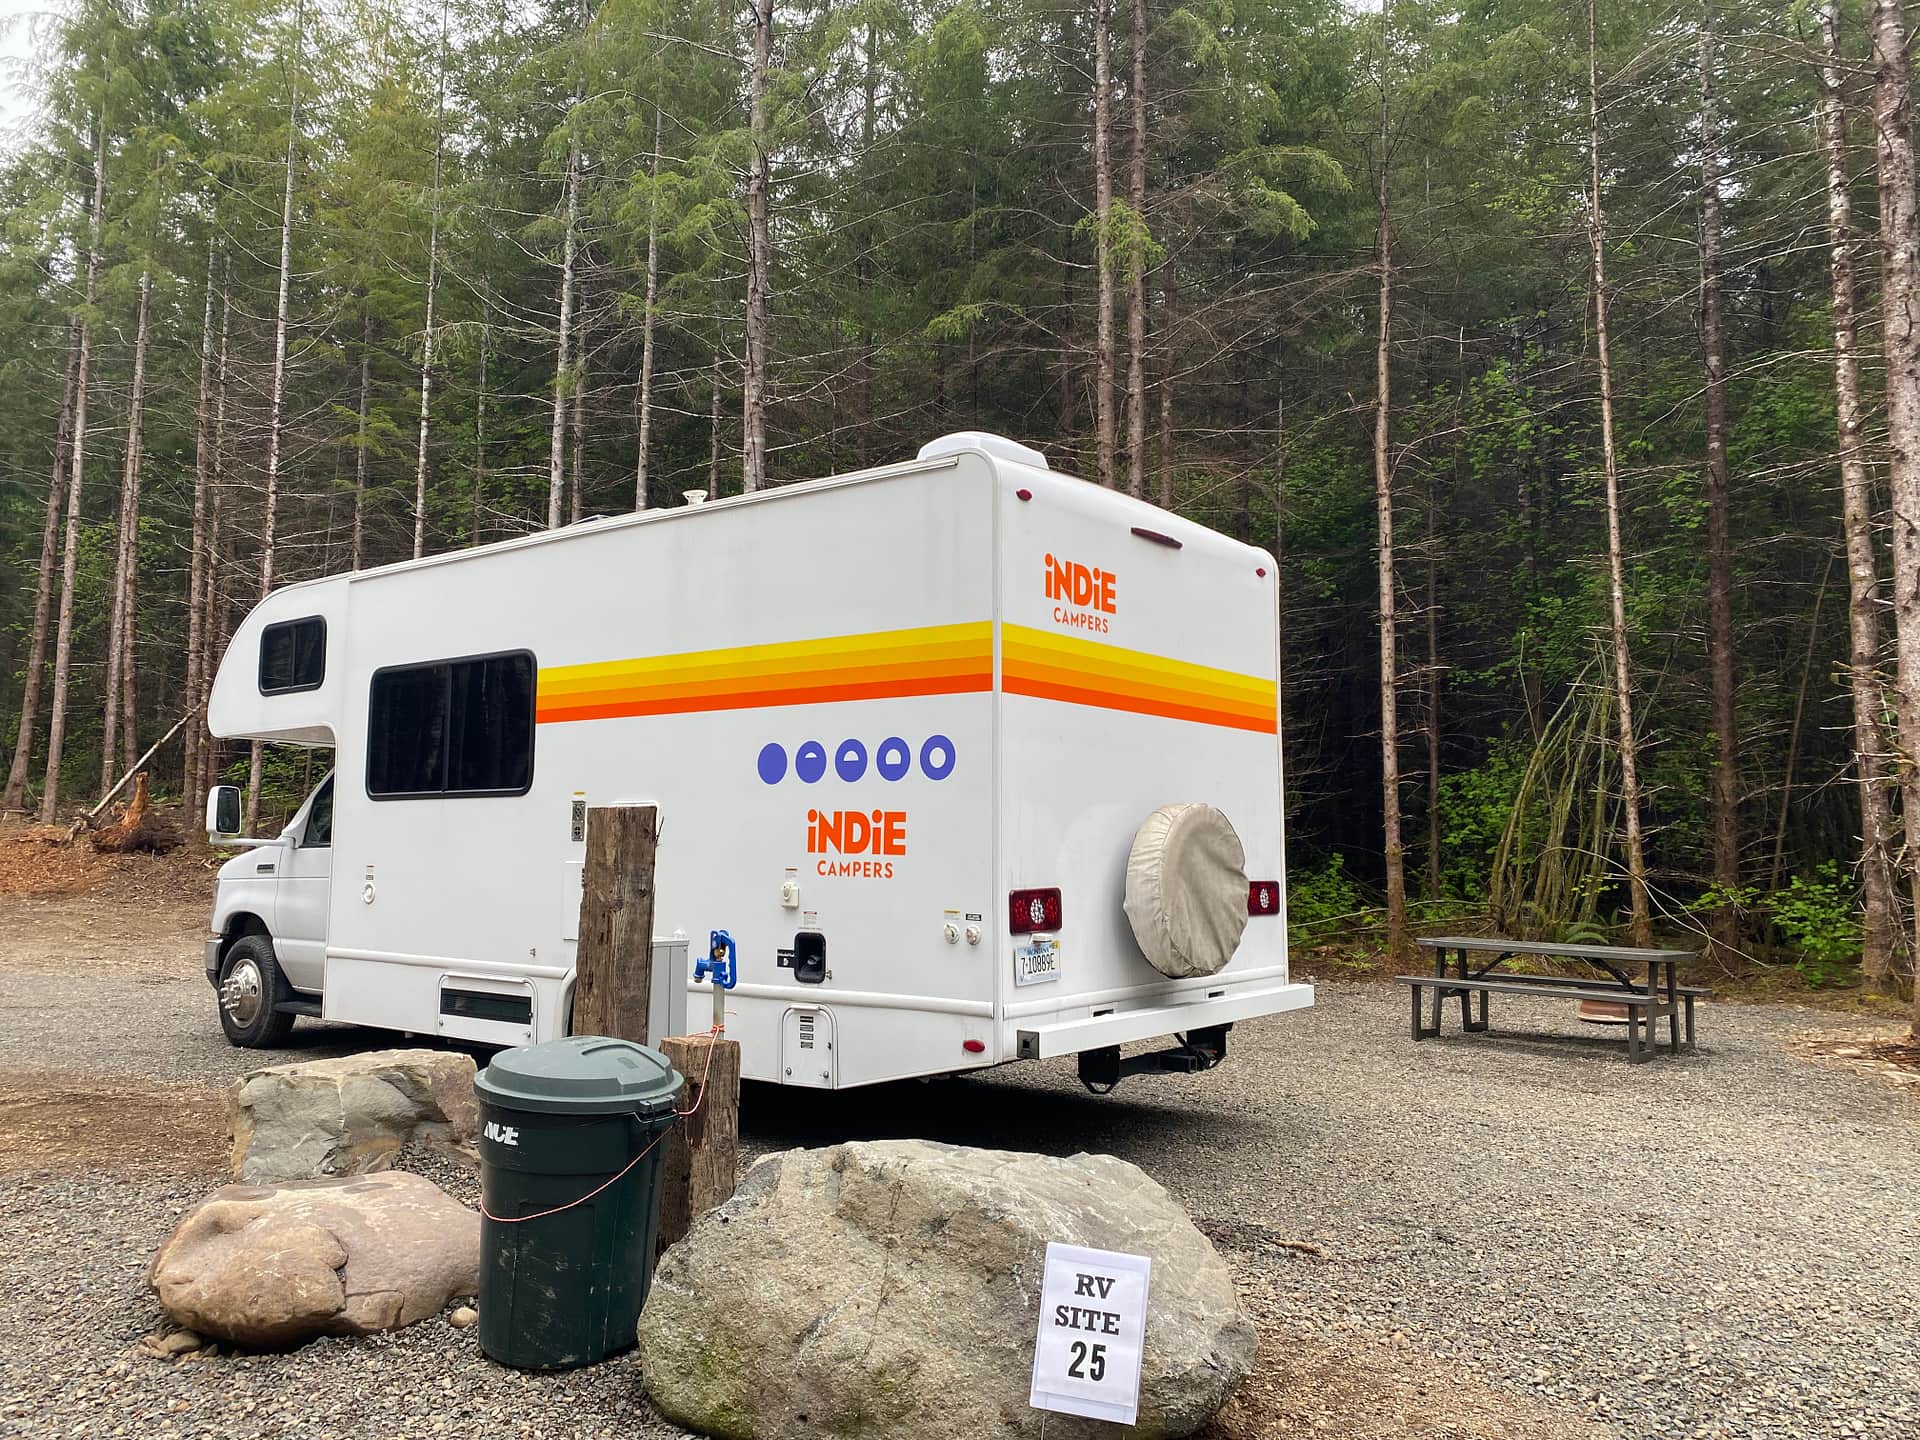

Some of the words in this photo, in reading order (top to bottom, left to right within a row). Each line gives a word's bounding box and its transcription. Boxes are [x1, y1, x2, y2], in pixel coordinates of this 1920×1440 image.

[1053, 607, 1109, 633] CAMPERS
[816, 859, 894, 879] CAMPERS
[1074, 1273, 1115, 1299] RV
[1055, 1305, 1120, 1336] SITE
[1068, 1341, 1106, 1382] 25
